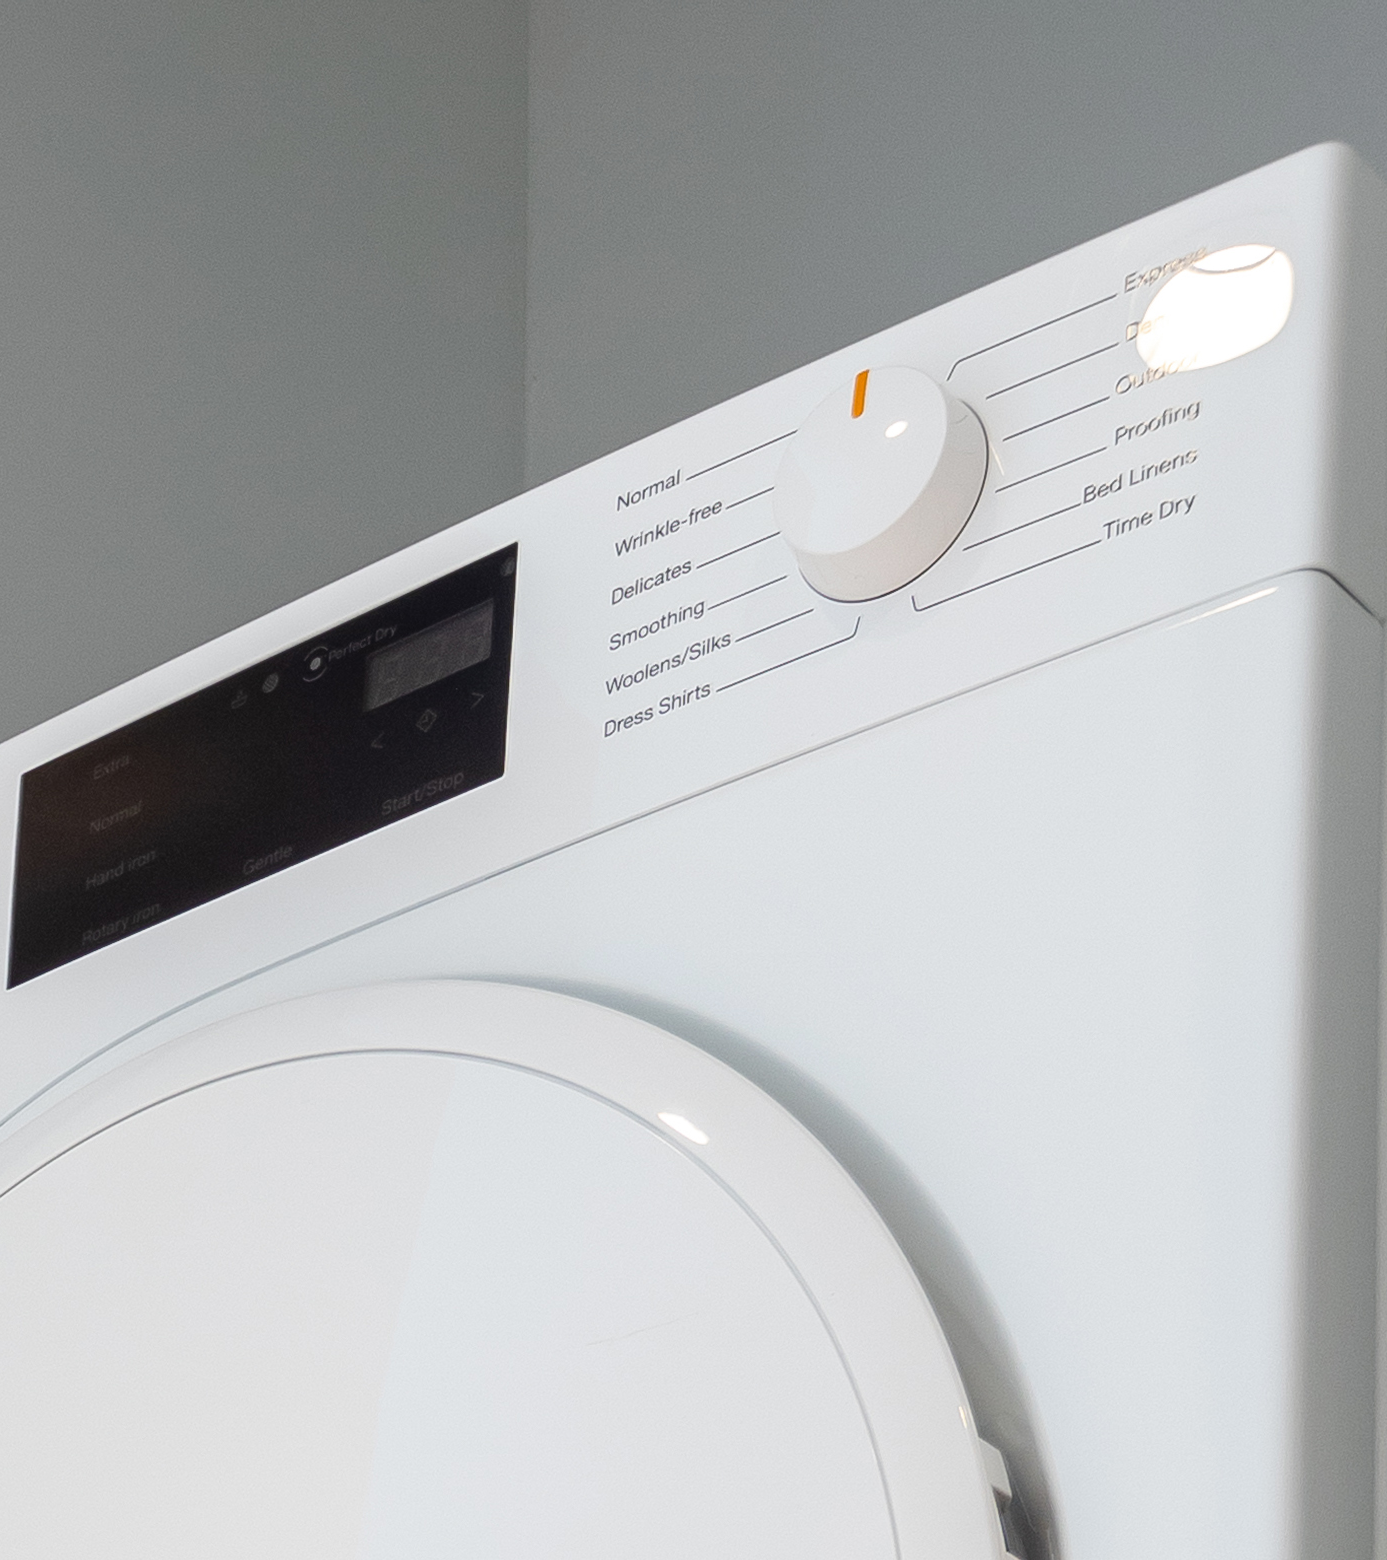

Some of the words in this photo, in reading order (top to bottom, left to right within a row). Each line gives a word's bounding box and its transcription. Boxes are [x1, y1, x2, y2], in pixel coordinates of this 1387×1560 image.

[1115, 399, 1202, 447] Proofing
[616, 470, 682, 511] Normal
[1082, 474, 1122, 505] Bed
[1127, 448, 1198, 487] Linens
[614, 499, 722, 557] Wrinkle-free
[1103, 510, 1154, 542] Time
[1157, 493, 1196, 530] Dry
[611, 558, 692, 605] Delicates
[328, 635, 372, 662] Perfect
[374, 623, 398, 644] Dry
[609, 602, 705, 651] Smoothing
[605, 631, 731, 695] Woolens/Silks
[603, 705, 654, 738] Dress
[658, 682, 712, 718] Shirts
[93, 754, 130, 781] Extra
[381, 771, 465, 816] Start/Stop
[89, 801, 143, 835] Normal
[85, 863, 125, 890] Hand
[127, 848, 157, 872] iron
[242, 844, 293, 876] Gentle
[82, 916, 130, 946] Rotary
[131, 901, 161, 925] iron
